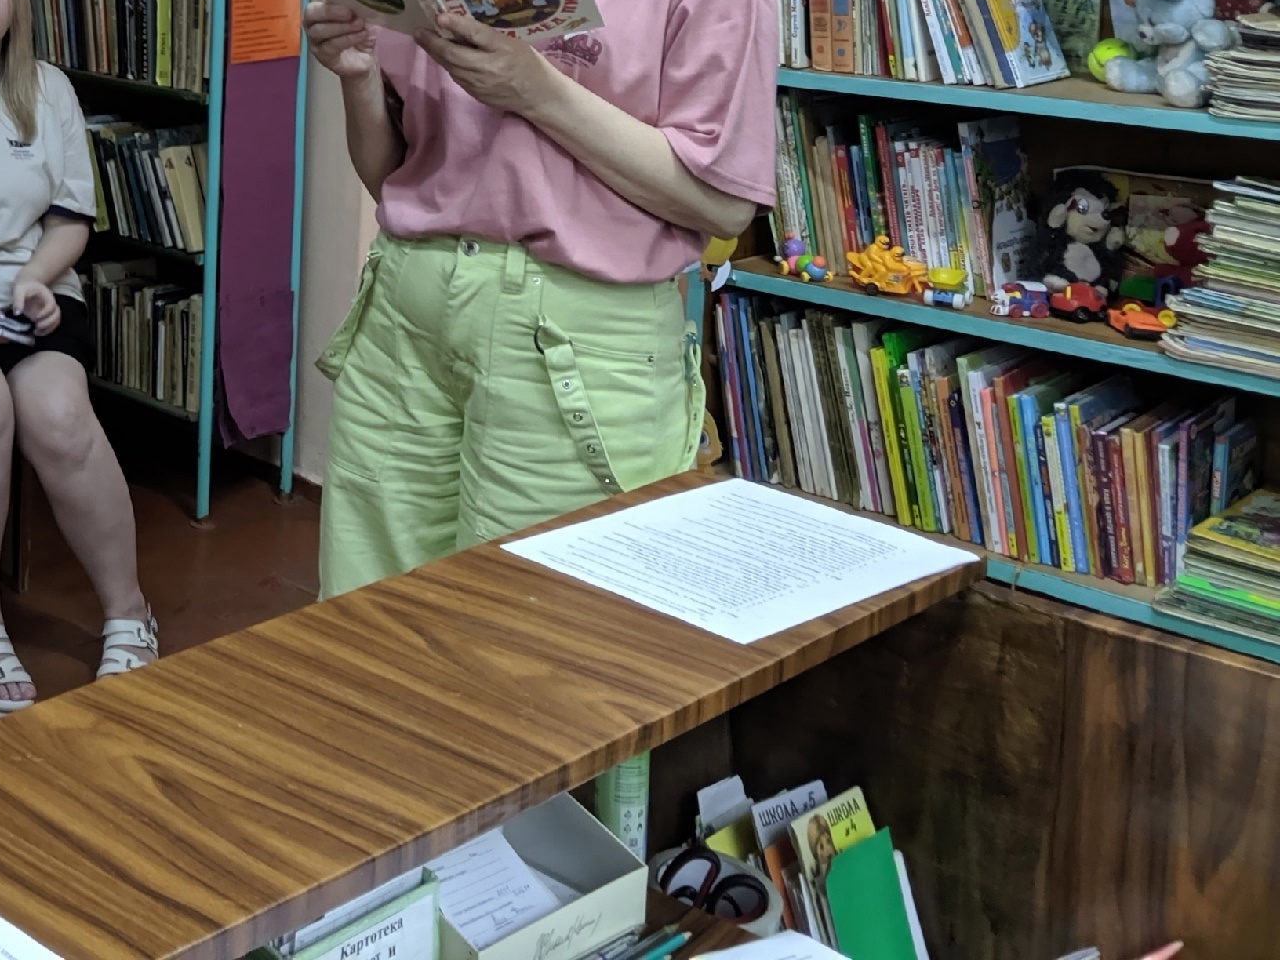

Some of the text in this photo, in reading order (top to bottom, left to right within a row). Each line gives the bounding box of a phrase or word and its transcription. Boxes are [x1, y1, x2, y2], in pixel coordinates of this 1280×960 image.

[757, 798, 800, 828] ШКОЛА
[826, 797, 861, 828] ШКОЛА
[339, 916, 405, 960] Картотека
